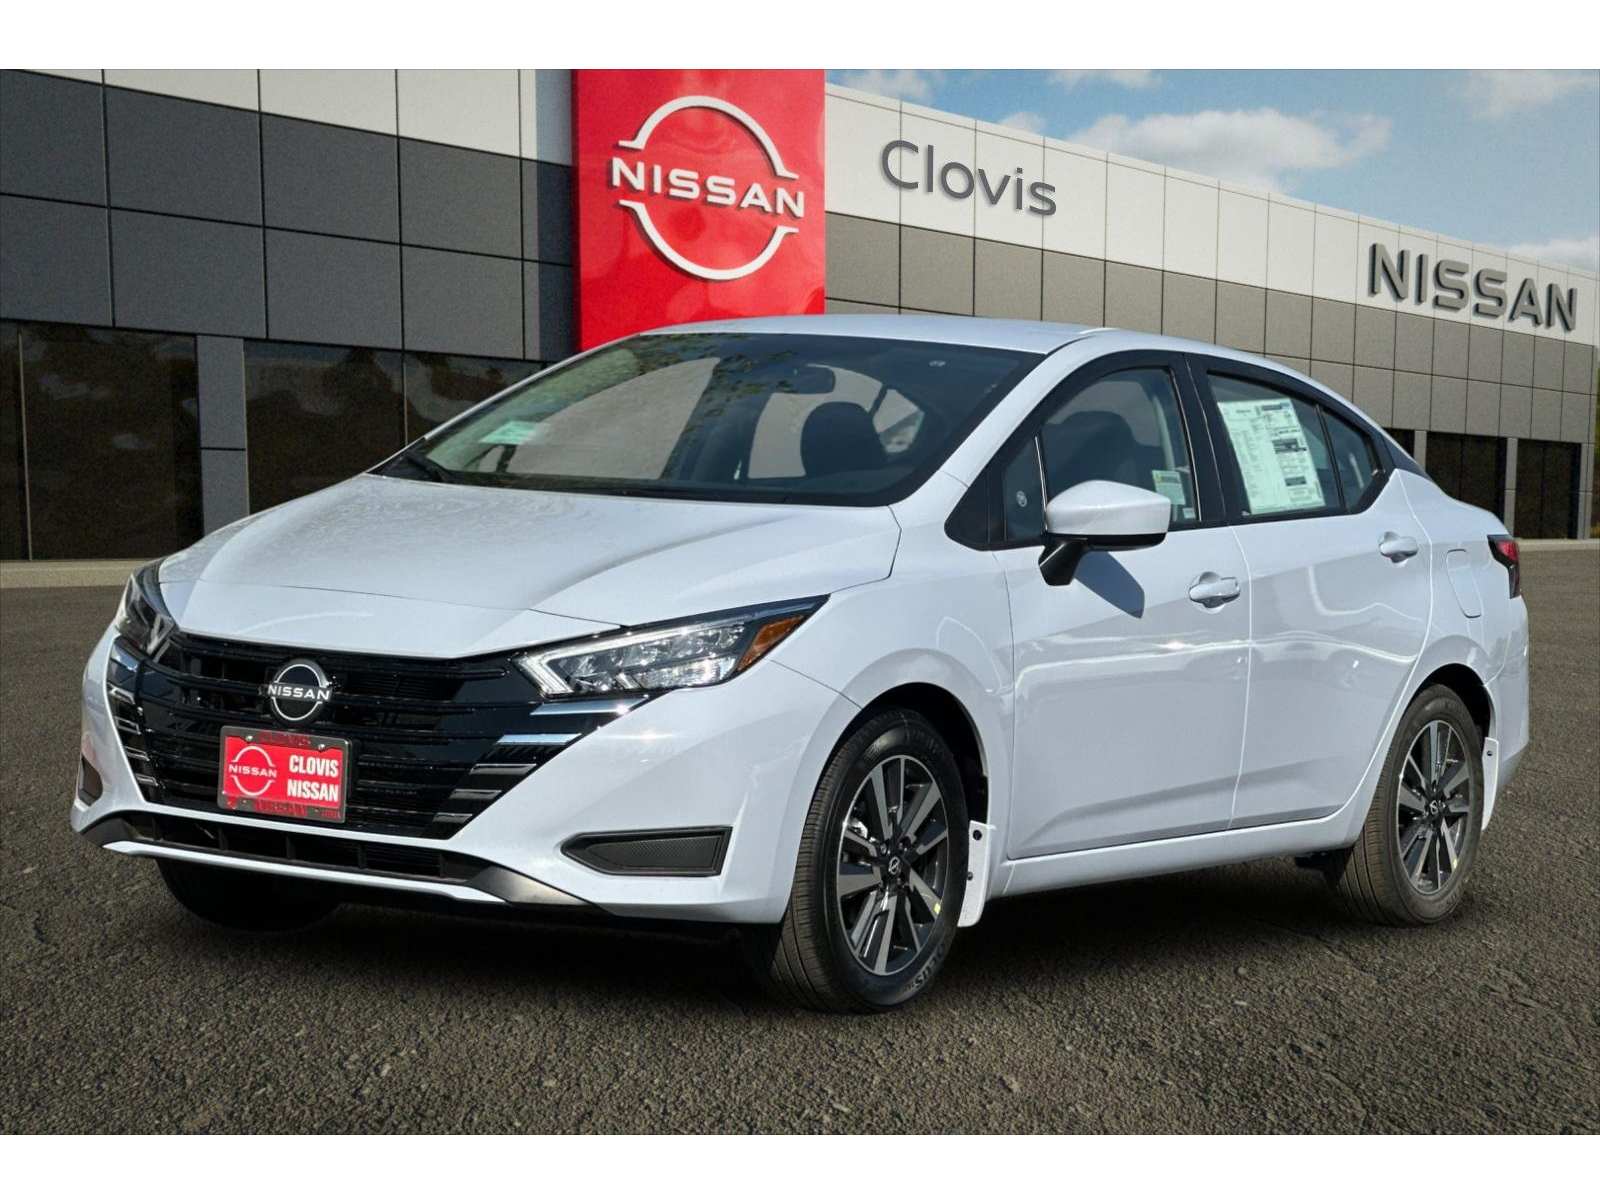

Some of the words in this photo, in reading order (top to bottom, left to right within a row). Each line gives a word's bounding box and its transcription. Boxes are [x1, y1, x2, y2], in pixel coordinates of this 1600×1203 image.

[610, 156, 805, 218] NISSAN
[881, 139, 1057, 216] Clovis
[1368, 243, 1578, 332] NISSAN
[267, 684, 330, 701] NISSAN
[228, 764, 277, 778] NISSAN
[289, 754, 339, 777] CLOVIS
[287, 779, 339, 801] NISSAN
